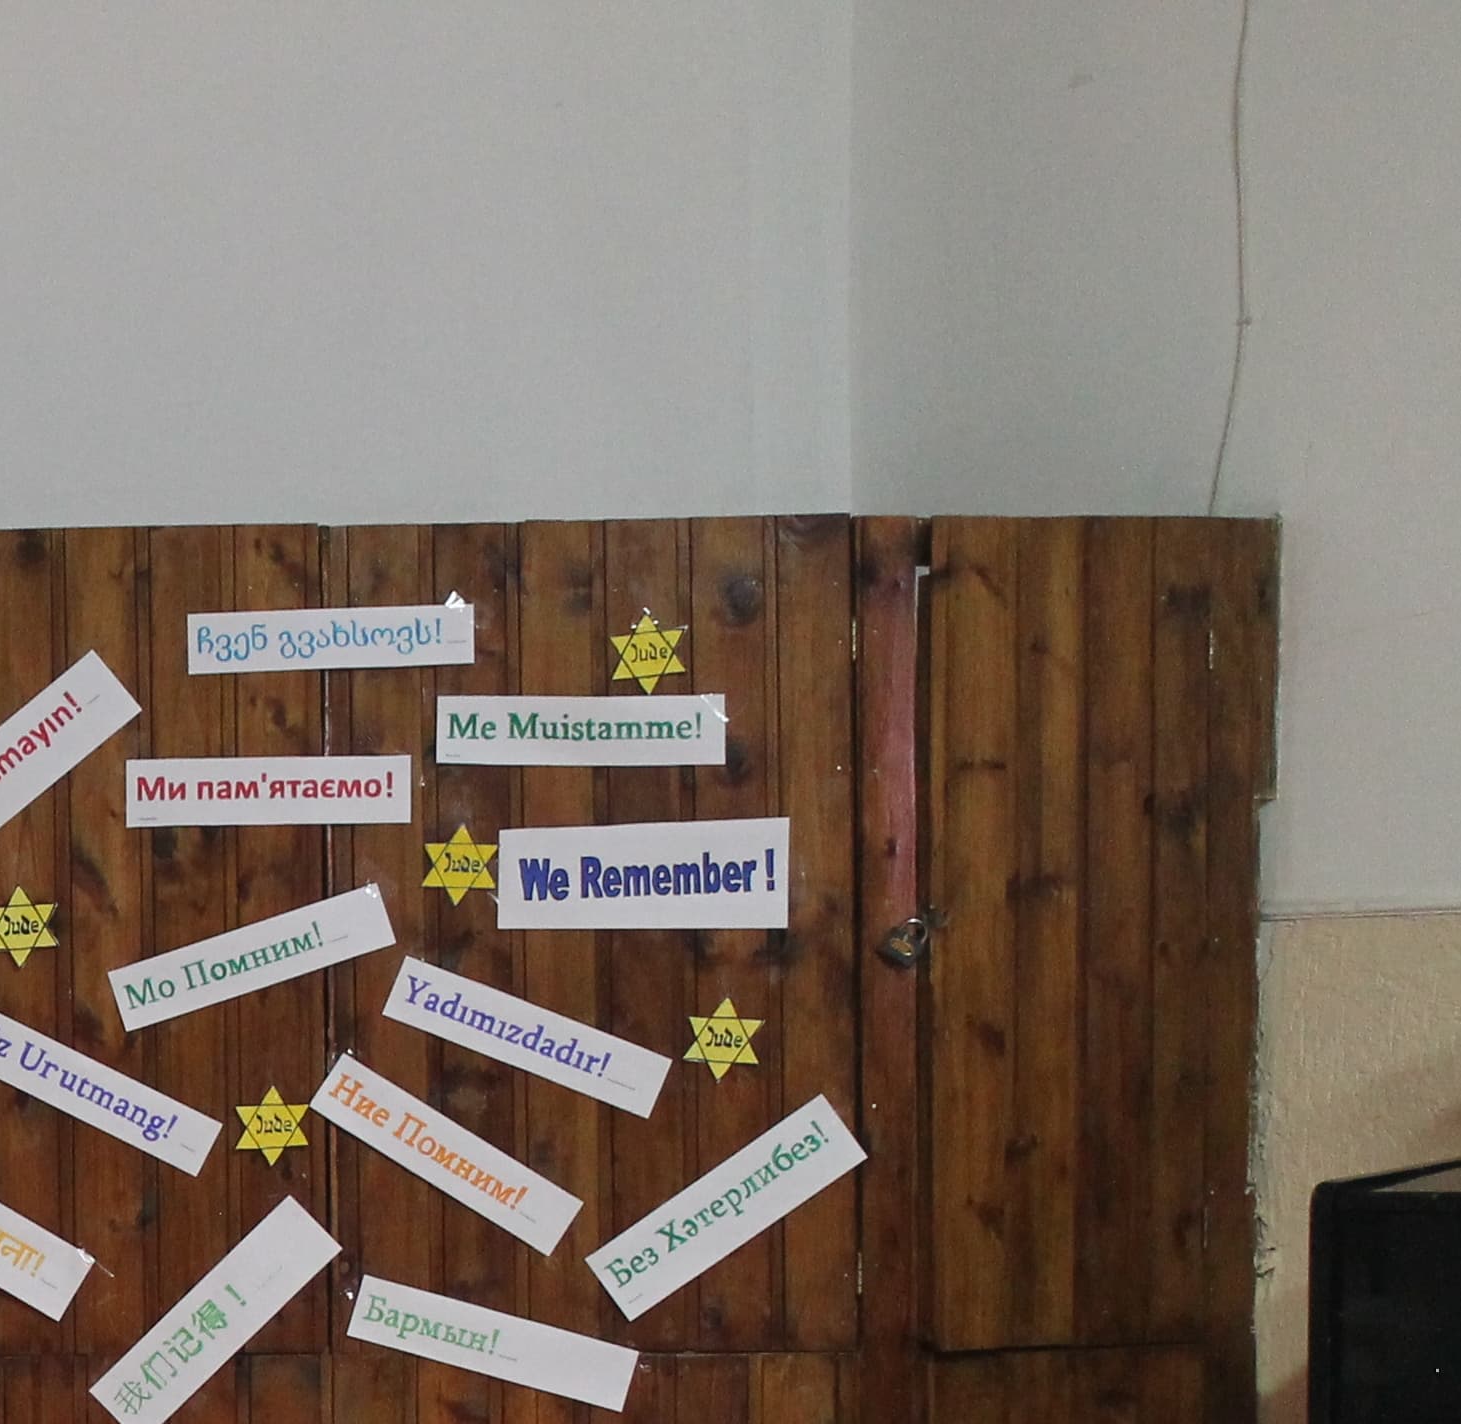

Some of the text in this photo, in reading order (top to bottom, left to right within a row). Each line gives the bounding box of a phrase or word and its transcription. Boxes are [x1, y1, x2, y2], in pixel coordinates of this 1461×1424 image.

[197, 617, 442, 662] ჩვენ გვახსოვს!
[630, 642, 668, 662] Jude
[448, 712, 701, 741] Me Muistamme!
[137, 772, 392, 801] Ми пам'ятаємо!
[444, 852, 480, 874] Jude
[519, 858, 569, 901] We
[3, 915, 40, 936] Jude
[124, 921, 323, 1009] Мо Помним!
[406, 975, 611, 1077] Yadımızdadır!
[706, 1026, 743, 1048] Jude
[20, 1041, 178, 1141] Urutmang!
[256, 1114, 292, 1134] Jude
[329, 1074, 528, 1210] Ние Помним!
[604, 1247, 659, 1288] Без
[362, 1294, 500, 1355] Бармын!
